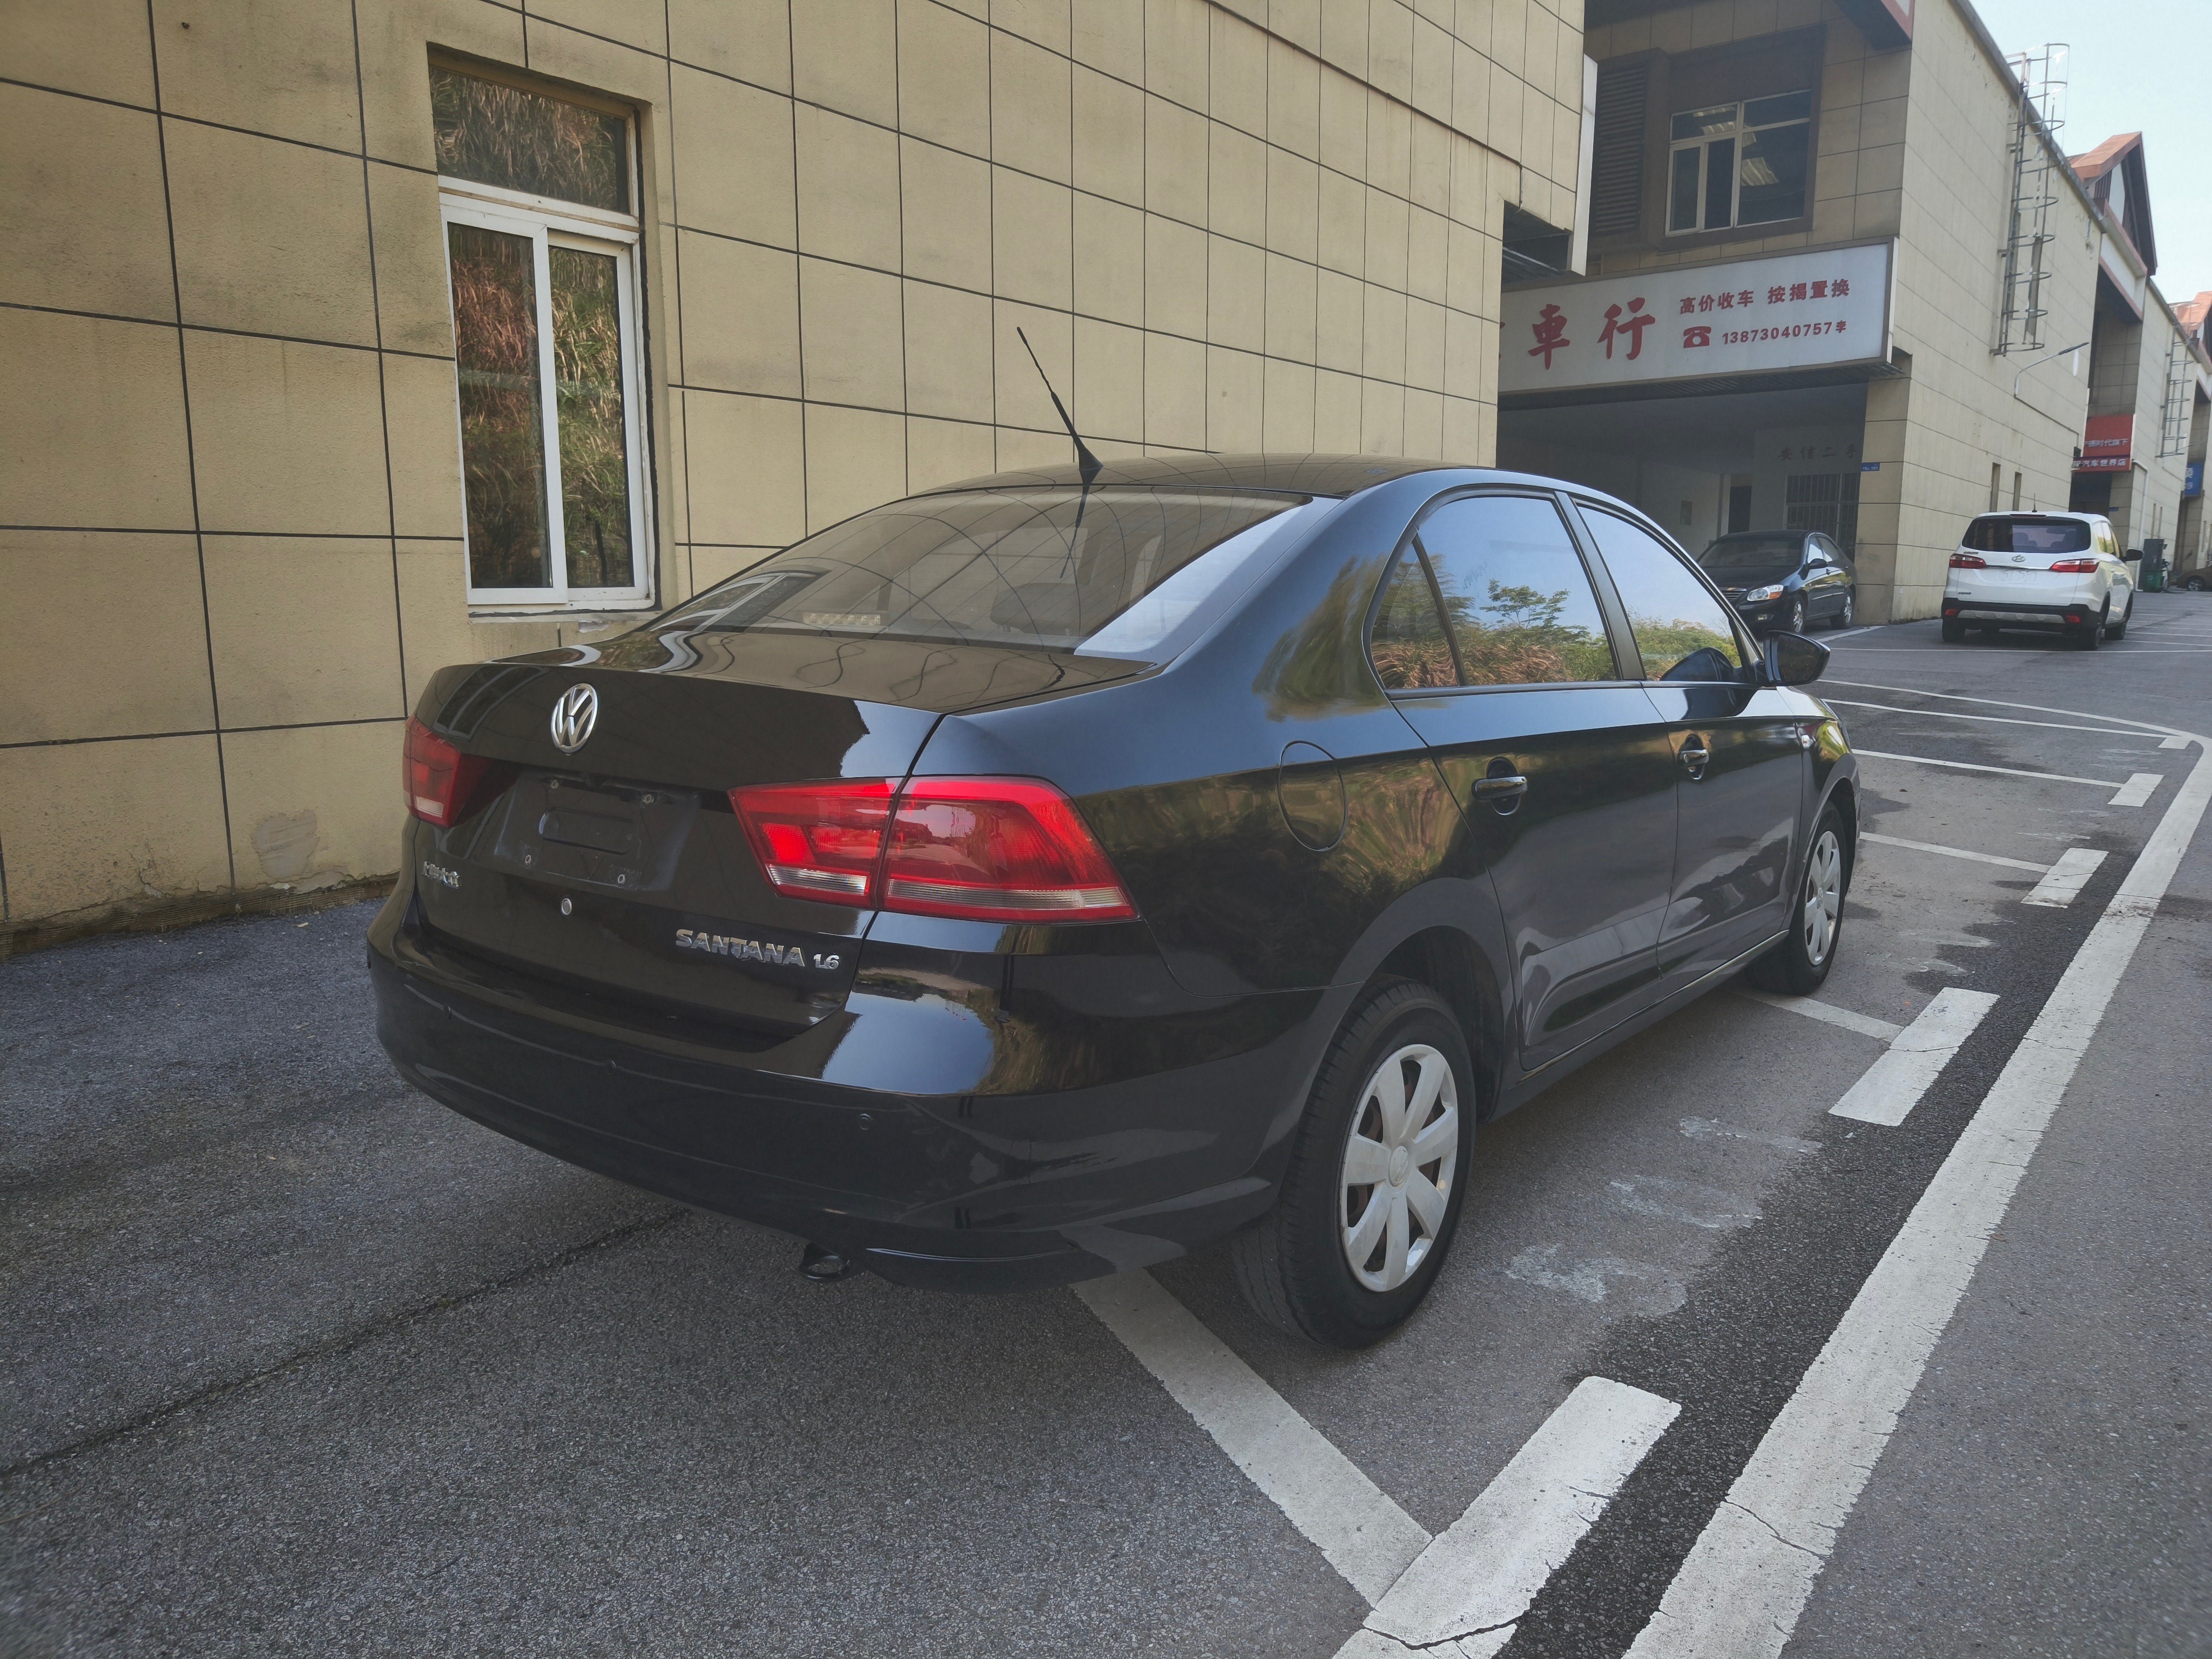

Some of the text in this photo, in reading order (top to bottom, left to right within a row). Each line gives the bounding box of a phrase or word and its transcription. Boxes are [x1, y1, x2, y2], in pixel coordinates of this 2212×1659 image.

[1680, 279, 1850, 314] 高价收车 按揭置换
[1499, 297, 1656, 370] 車行
[676, 929, 805, 967] SANTANA
